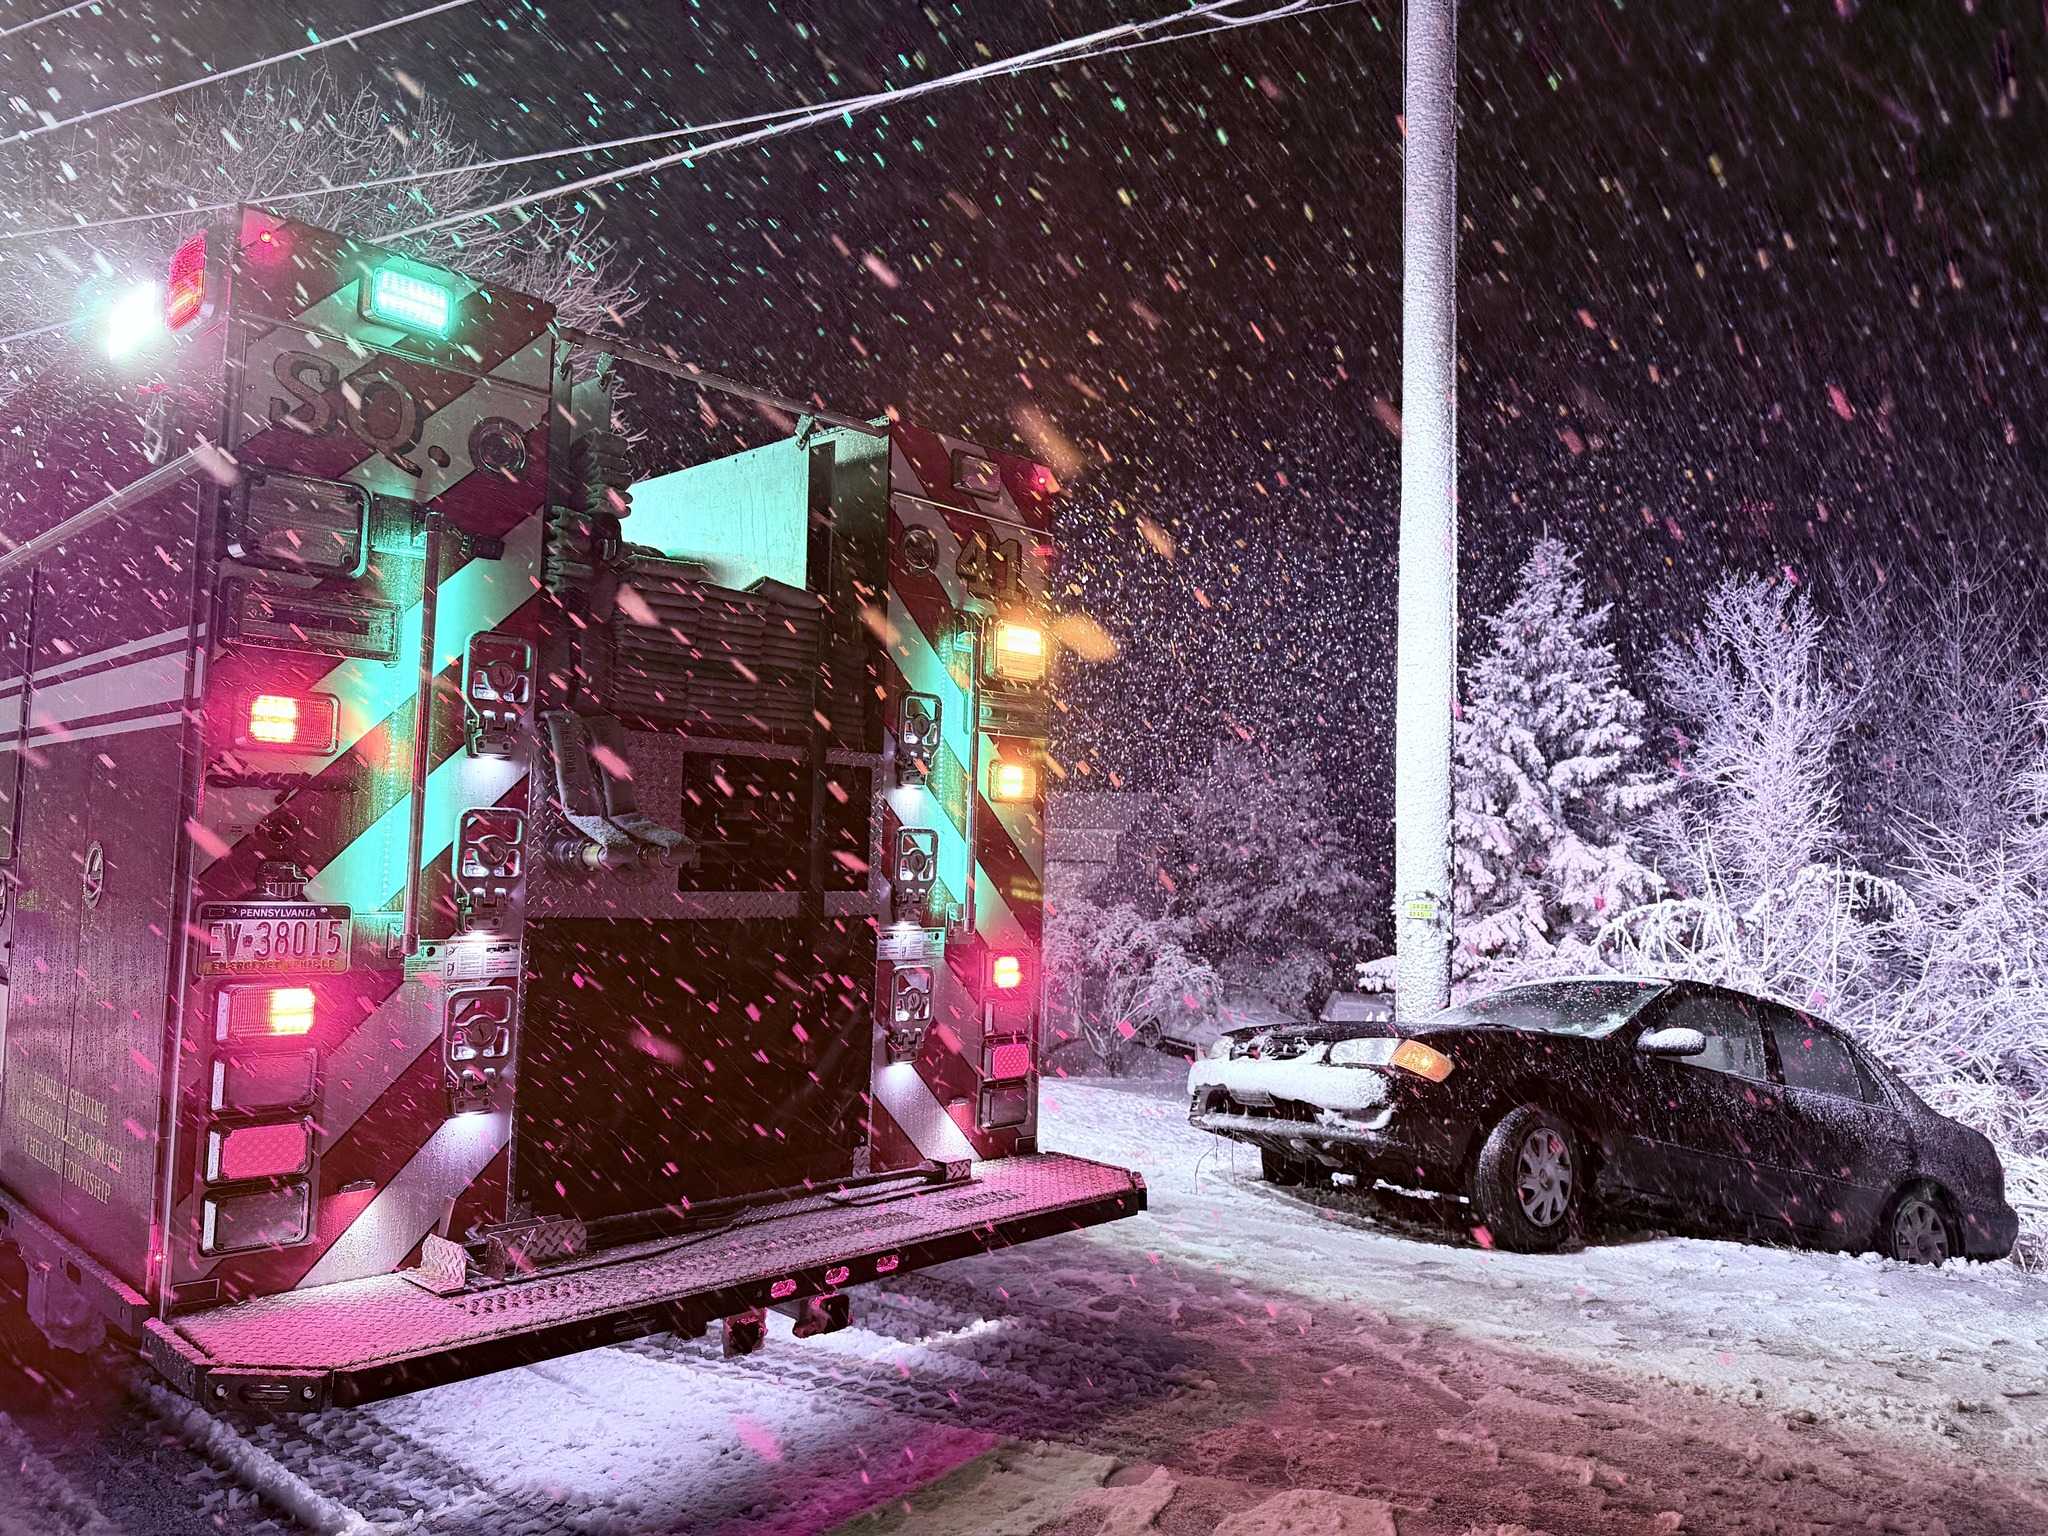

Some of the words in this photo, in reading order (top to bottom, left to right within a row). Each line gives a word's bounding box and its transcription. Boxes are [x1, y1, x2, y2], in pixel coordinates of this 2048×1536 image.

[956, 529, 1031, 601] 41
[240, 908, 316, 917] PENNSYLVANIA
[33, 1072, 69, 1106] PROUDLY
[69, 1087, 108, 1127] SERVING
[19, 1097, 77, 1147] WRIGHTSVILLE
[78, 1129, 122, 1174] BOROUGH
[29, 1137, 62, 1175] HELLAM
[63, 1158, 111, 1205] TOWNSHIP
